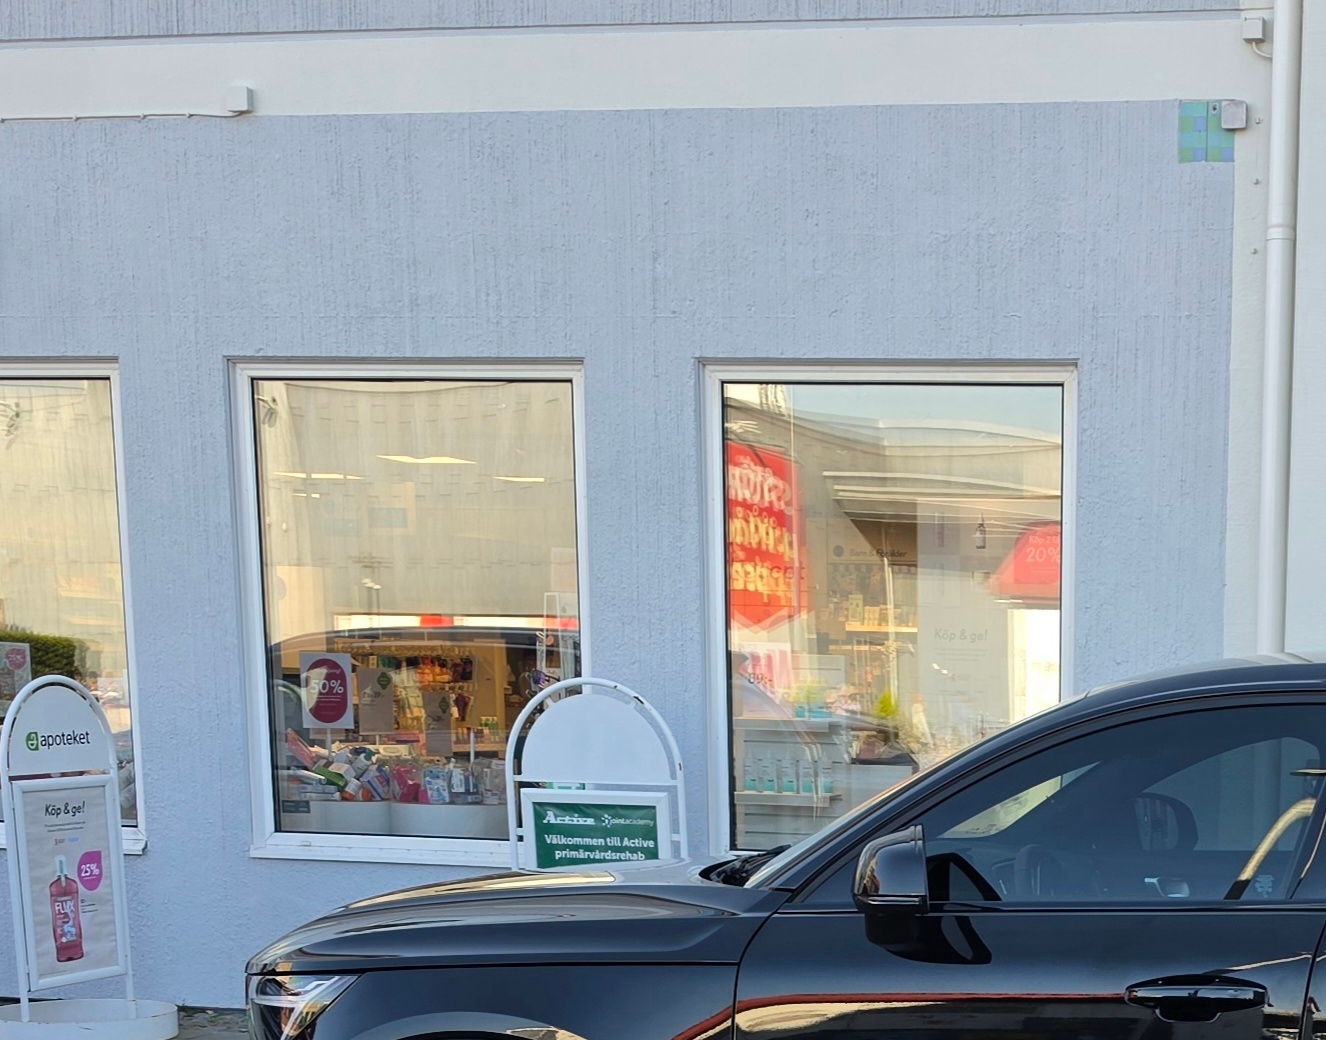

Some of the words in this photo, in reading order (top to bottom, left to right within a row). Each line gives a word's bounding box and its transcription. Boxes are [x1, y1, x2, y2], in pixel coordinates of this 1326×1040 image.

[309, 679, 344, 694] 50%
[40, 730, 91, 749] apoteket
[45, 803, 61, 818] Köp
[63, 803, 70, 814] &
[71, 801, 86, 817] ge!
[544, 834, 605, 847] Välkommen
[606, 837, 621, 847] till
[622, 837, 655, 848] Active
[555, 848, 646, 861] primärvårdsrehab
[80, 863, 101, 877] 25%
